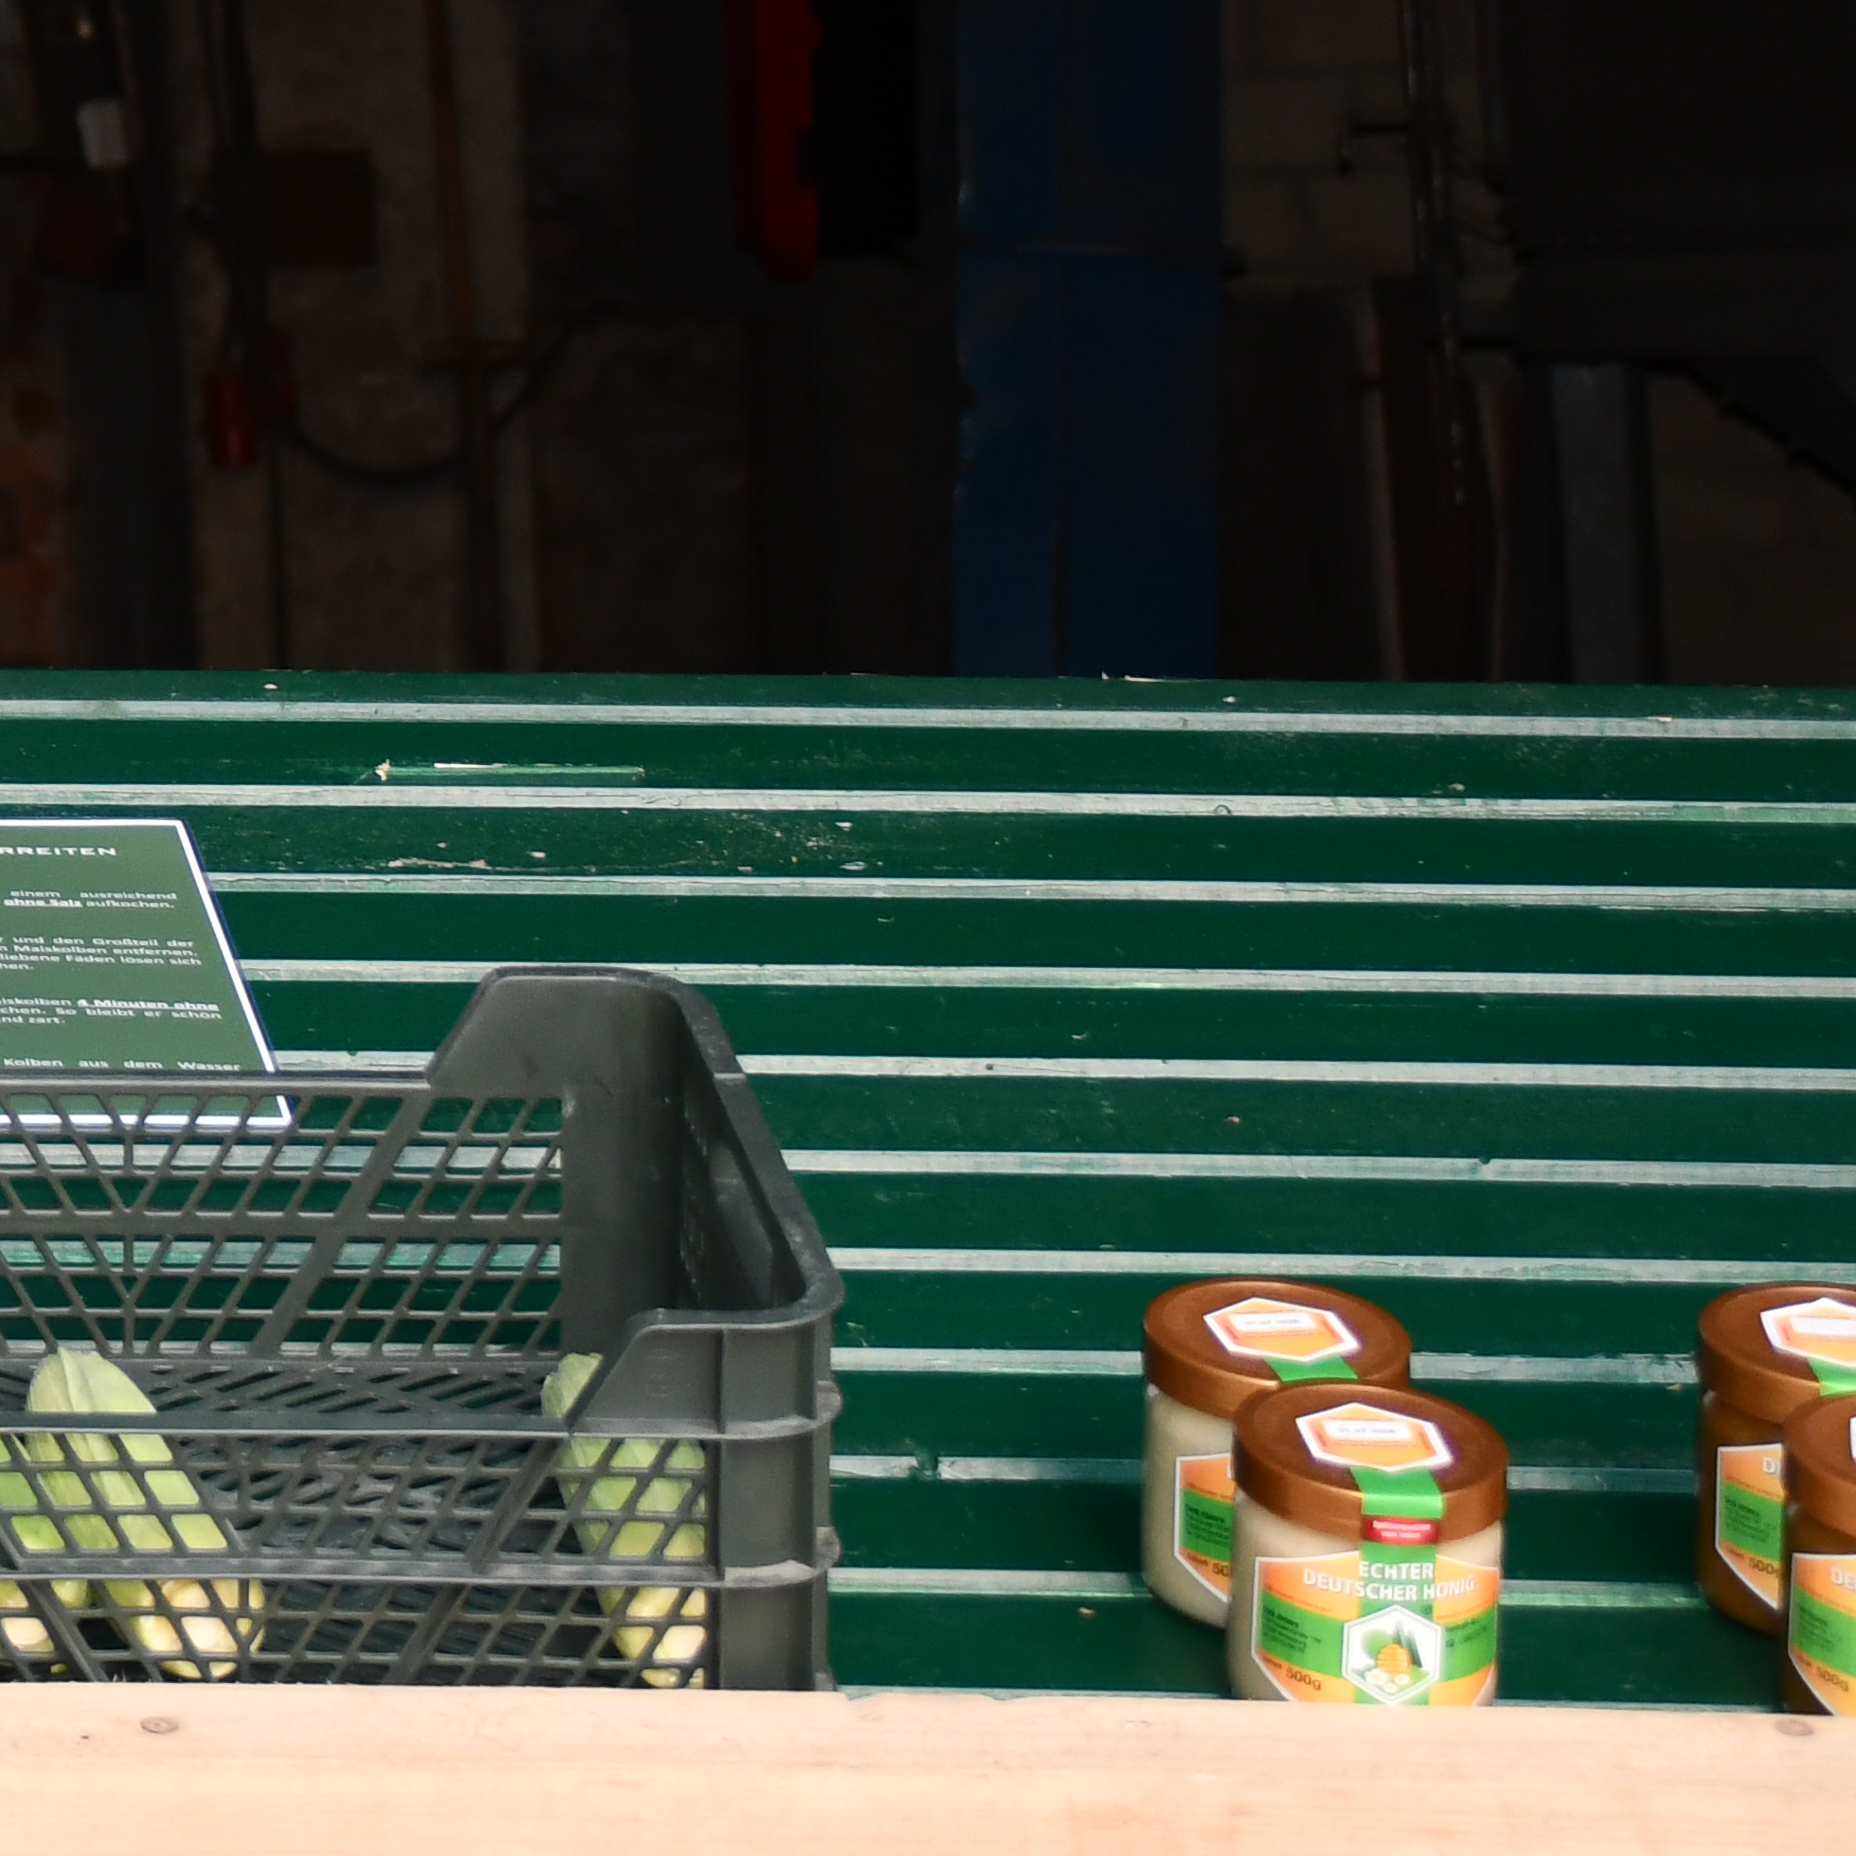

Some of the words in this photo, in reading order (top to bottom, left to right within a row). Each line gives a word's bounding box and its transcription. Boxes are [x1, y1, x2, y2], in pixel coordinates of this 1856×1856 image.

[10, 890, 62, 898] einem
[79, 891, 177, 900] ausreichend
[3, 898, 48, 908] ohne
[12, 936, 45, 944] und
[52, 937, 85, 945] den
[166, 939, 194, 948] der
[13, 944, 111, 955] Maiskolben
[112, 947, 198, 957] entfernen.
[169, 957, 202, 966] sich
[93, 999, 169, 1010] Minuten
[55, 1007, 77, 1016] So
[85, 1008, 136, 1017] bleibt
[143, 1010, 163, 1018] er
[27, 1015, 66, 1024] zart.
[3, 1058, 64, 1068] Kolben
[78, 1059, 109, 1069] aus
[123, 1059, 163, 1069] dem
[177, 1060, 241, 1072] Wasser
[1359, 1561, 1434, 1581] ECHTER
[1302, 1568, 1418, 1602] DEUTSCHER
[1423, 1574, 1476, 1600] HONIG
[1285, 1664, 1322, 1692] 500g
